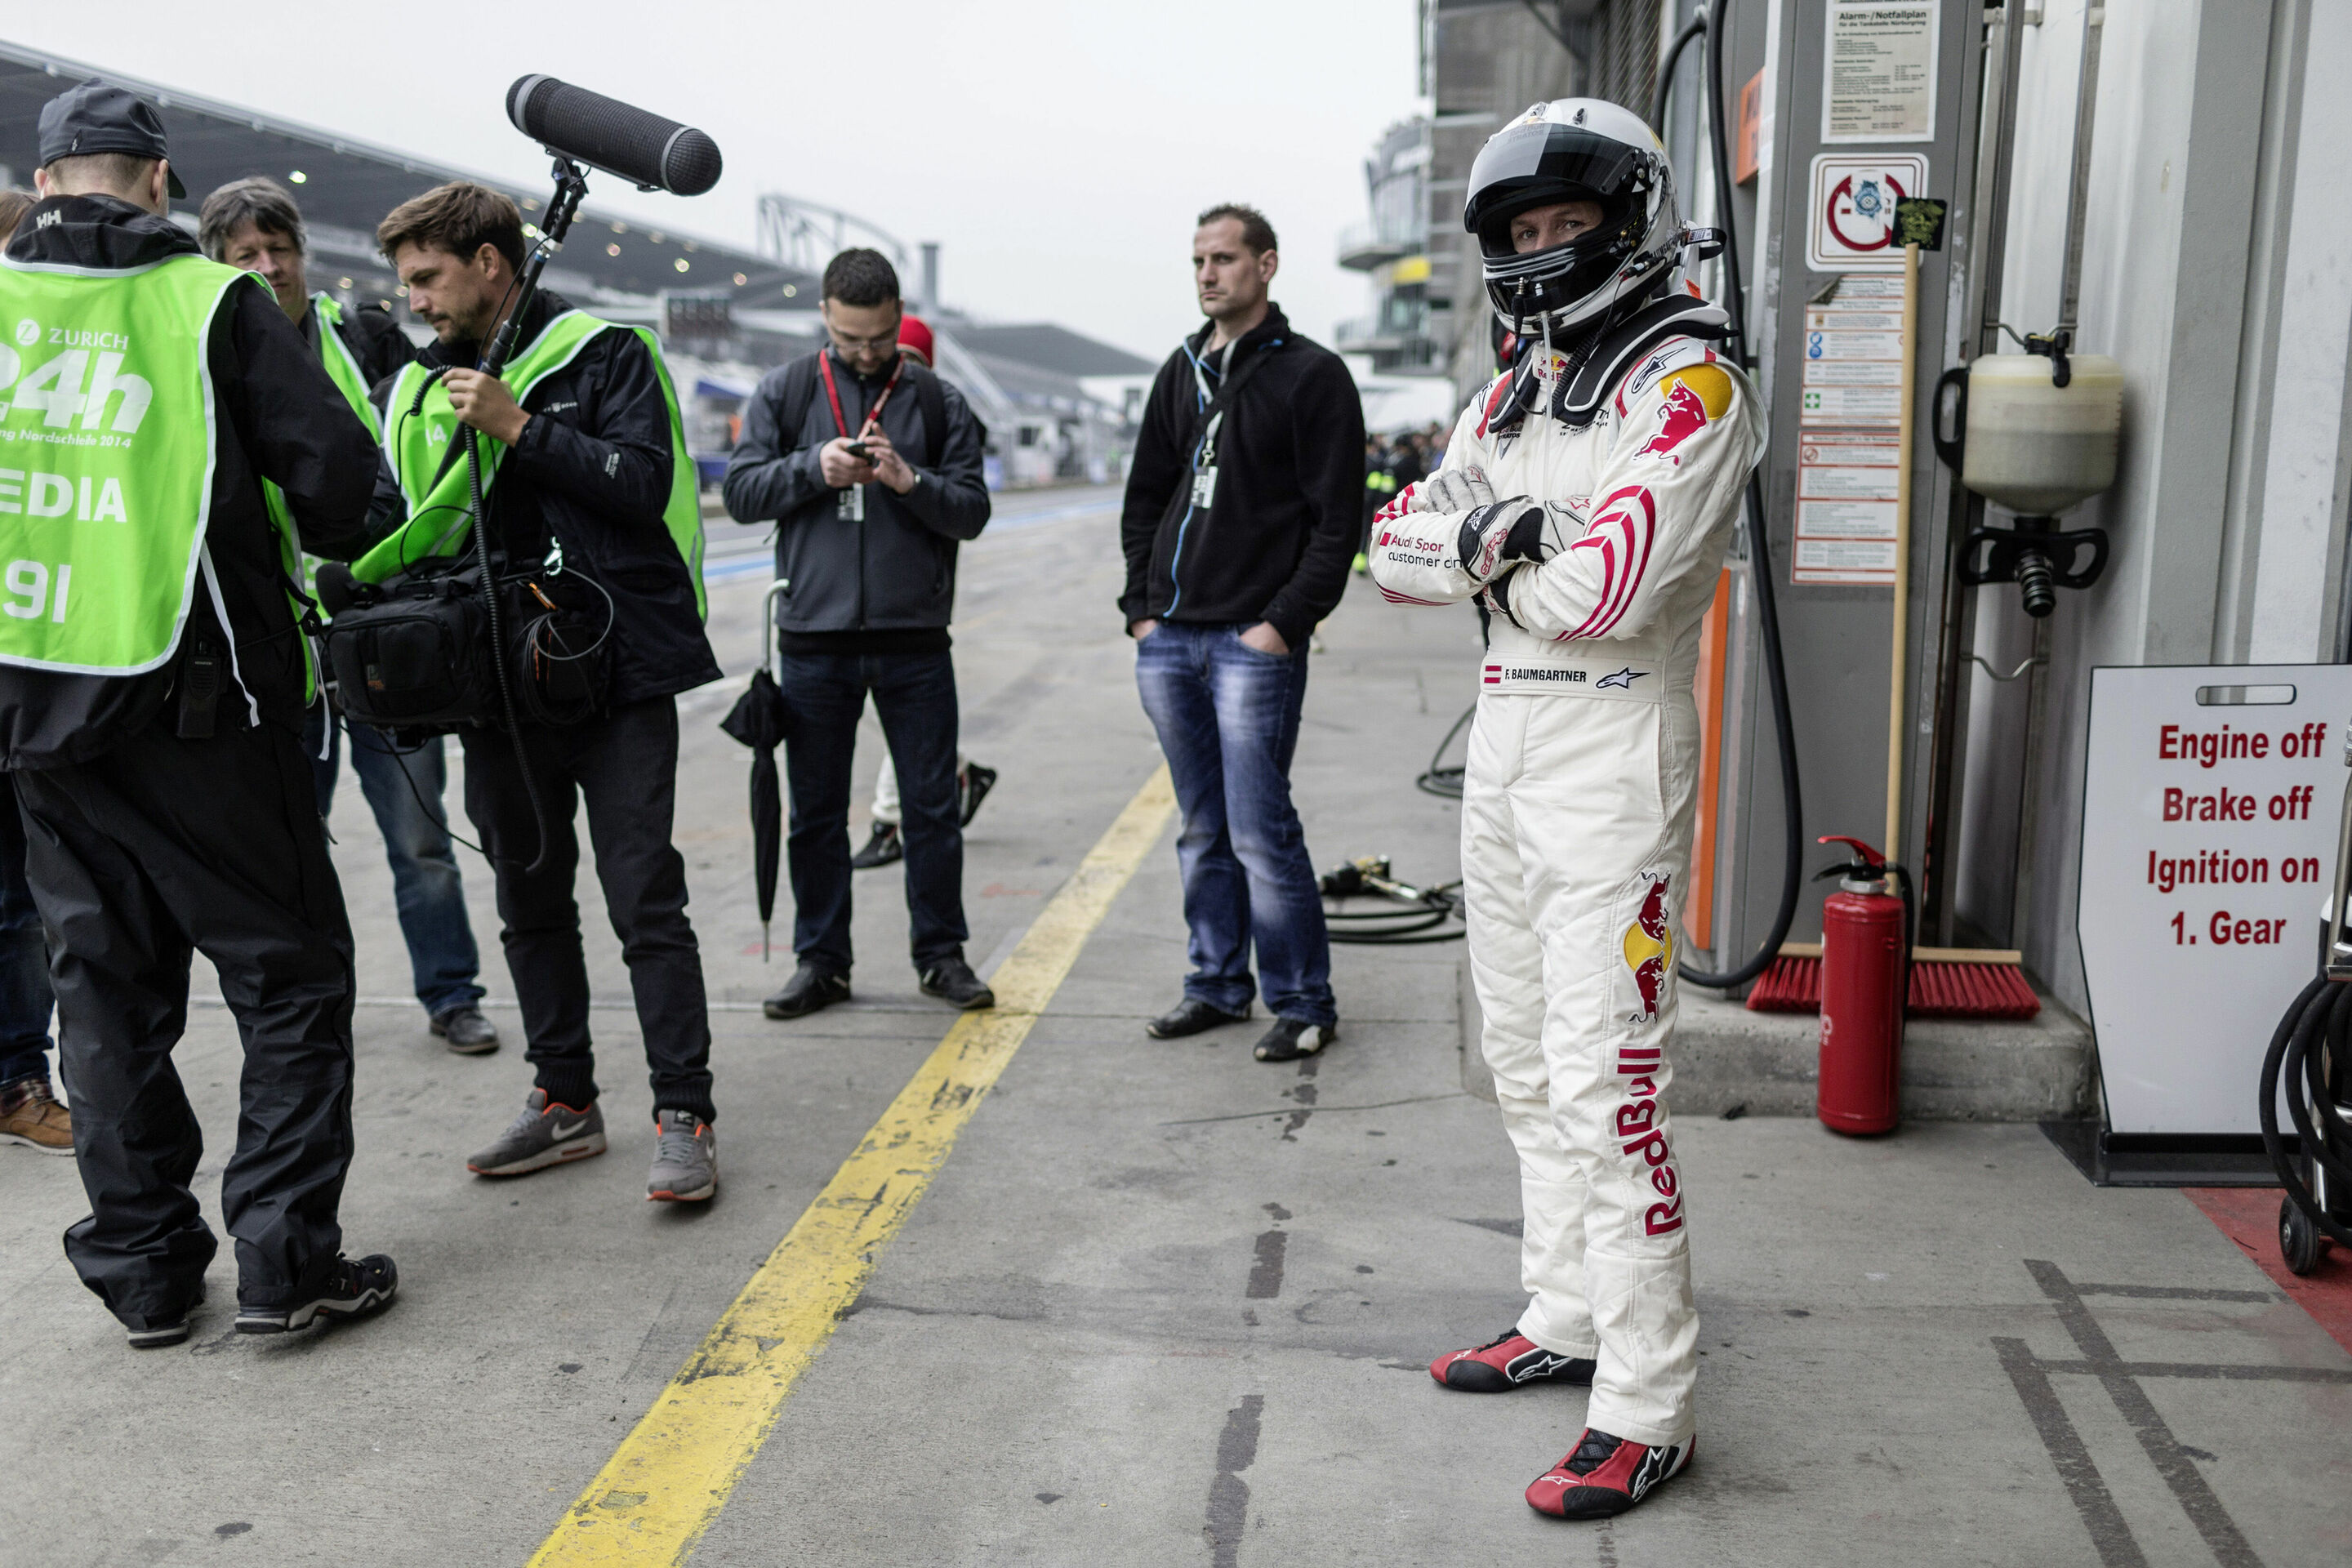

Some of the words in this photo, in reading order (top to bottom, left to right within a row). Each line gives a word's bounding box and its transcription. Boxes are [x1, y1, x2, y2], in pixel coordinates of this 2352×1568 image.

[47, 327, 130, 350] ZURICH
[20, 428, 97, 447] Nordschleife
[100, 434, 132, 449] 2014
[1391, 534, 1414, 549] Audi
[1414, 537, 1444, 553] Spor
[1388, 551, 1441, 568] customer
[1505, 669, 1510, 680] F.
[1512, 668, 1587, 683] BAUMGARTNER
[2159, 724, 2270, 768] Engine
[2281, 722, 2328, 759] off
[2163, 786, 2257, 822] Brake
[2268, 785, 2314, 821] off
[2148, 849, 2269, 893] Ignition
[2281, 857, 2320, 884] on
[2171, 911, 2197, 945] 1.
[2209, 910, 2287, 945] Gear
